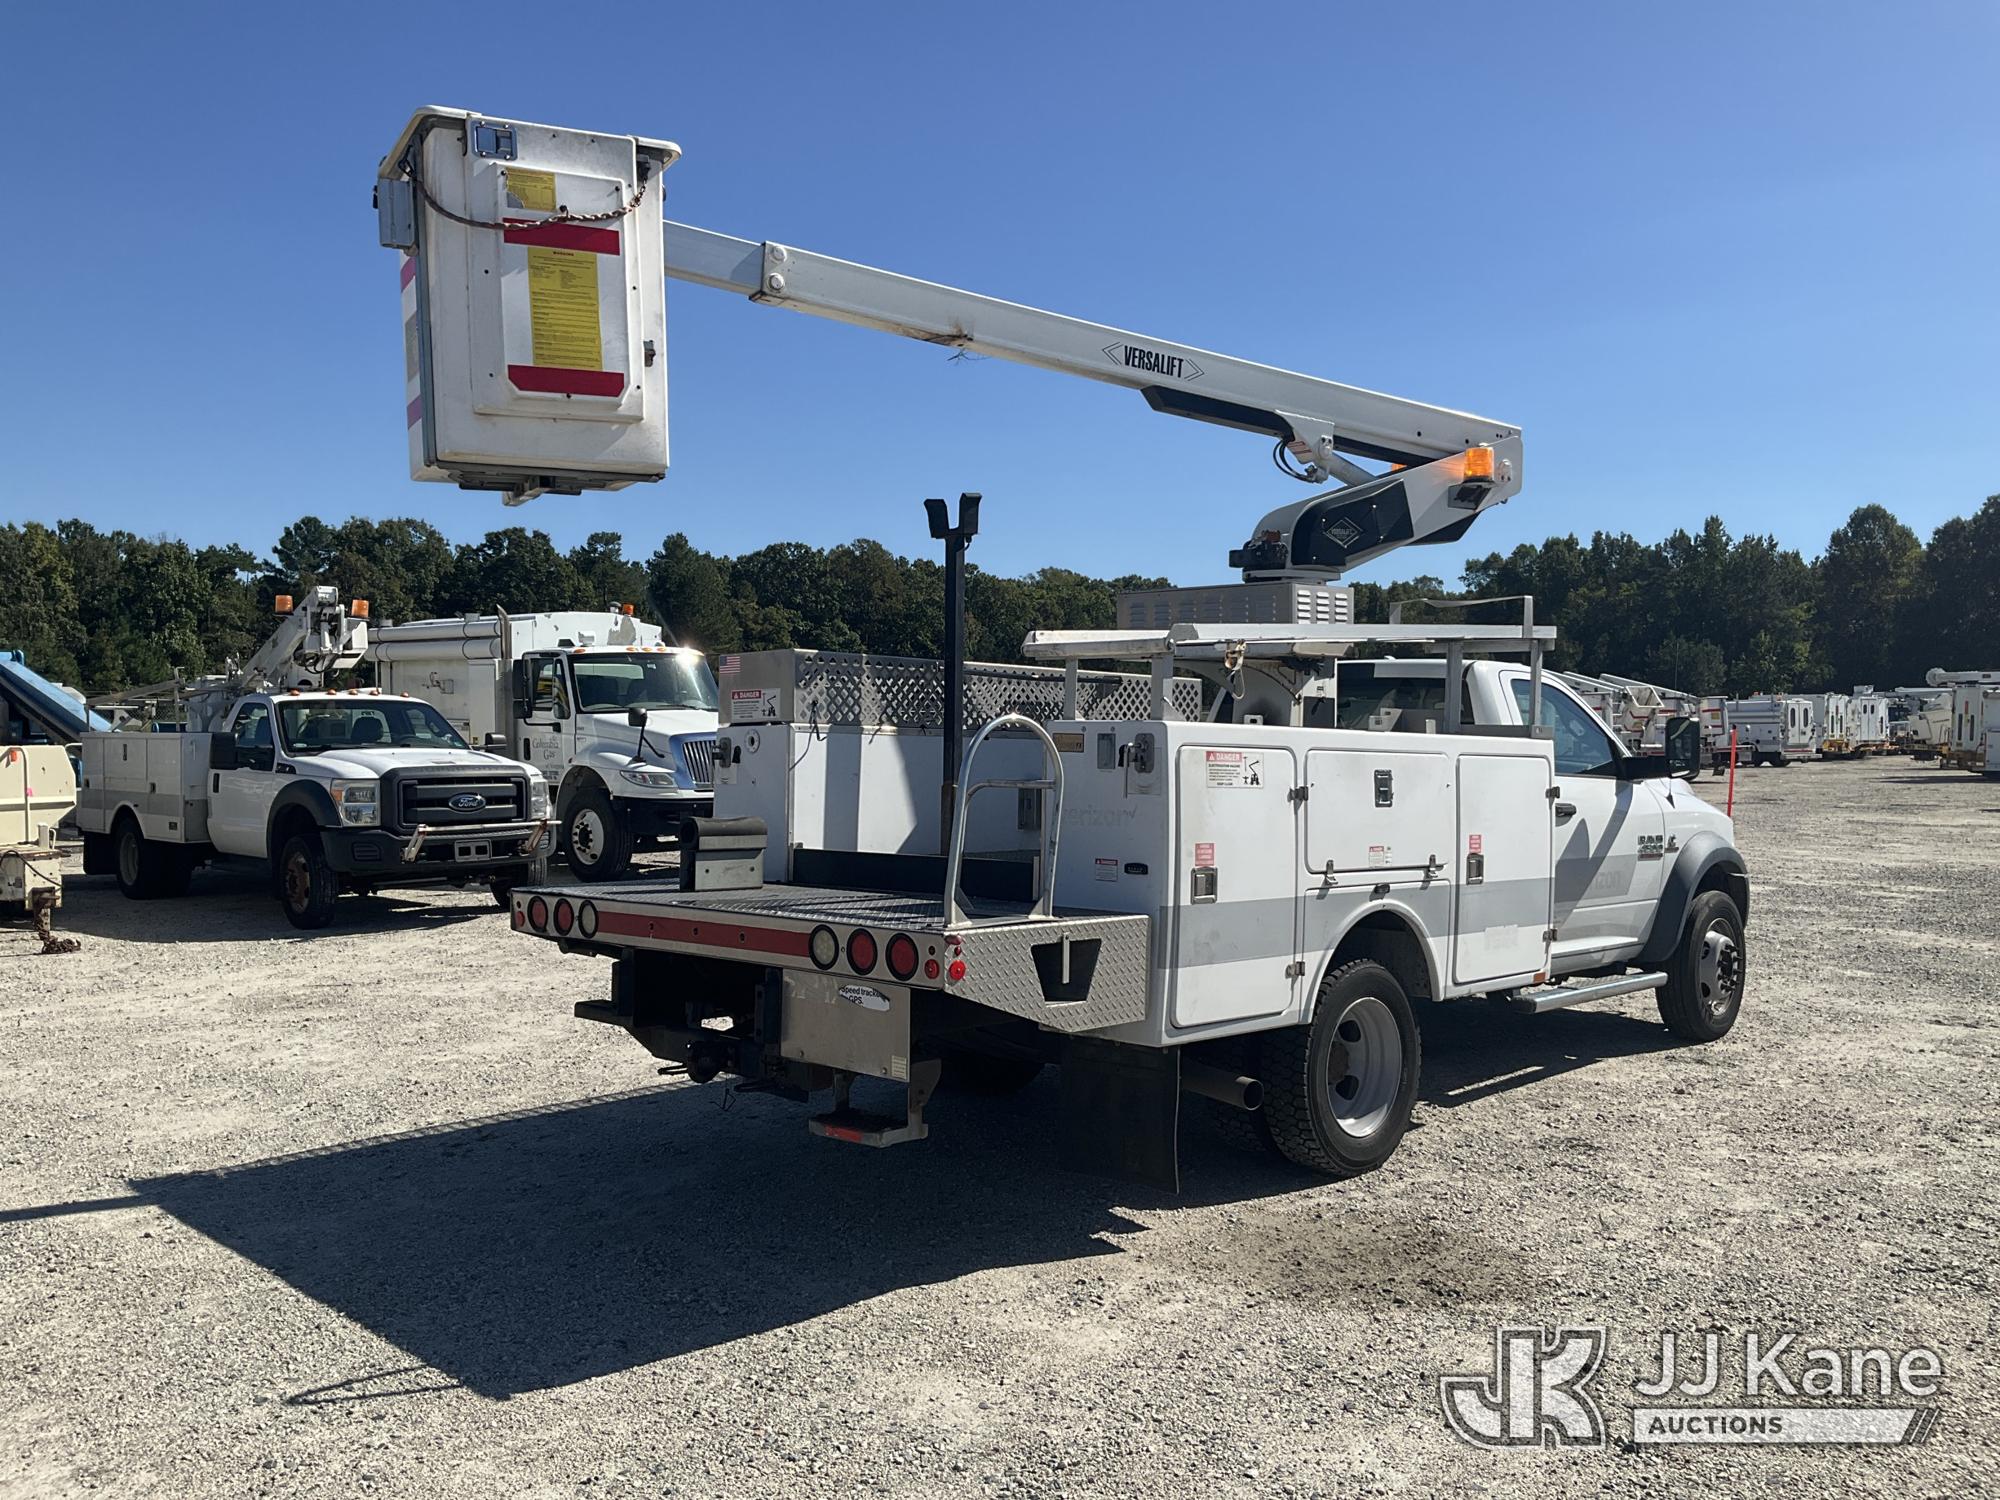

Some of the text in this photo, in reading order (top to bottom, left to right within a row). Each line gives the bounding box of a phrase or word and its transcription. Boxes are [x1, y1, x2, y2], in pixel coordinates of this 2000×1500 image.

[1124, 345, 1184, 378] VERSALIFT
[1216, 752, 1241, 761] DANGER
[458, 797, 479, 807] Ford
[1637, 835, 1663, 845] RAM
